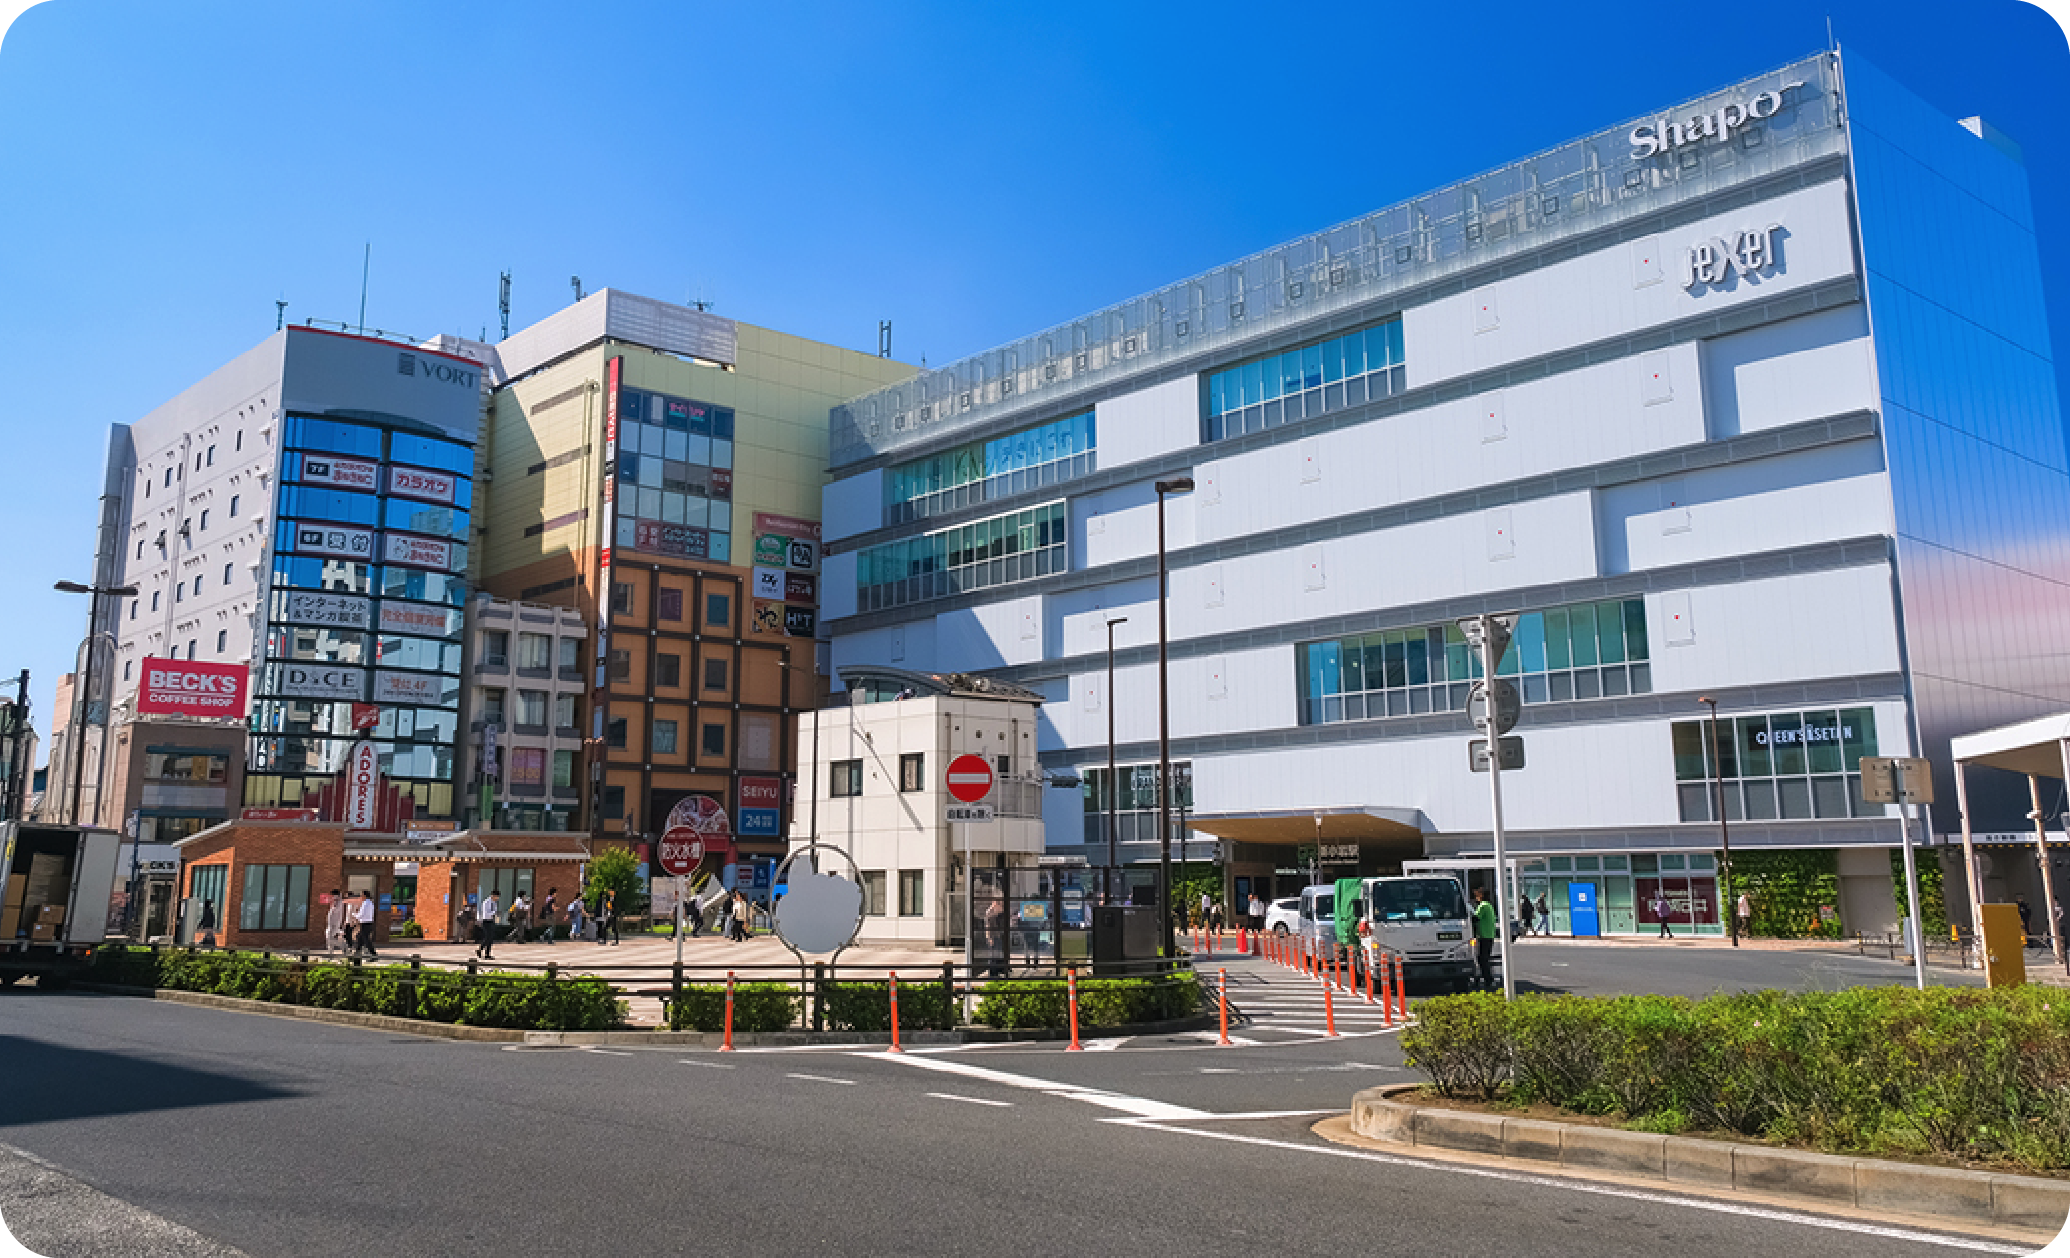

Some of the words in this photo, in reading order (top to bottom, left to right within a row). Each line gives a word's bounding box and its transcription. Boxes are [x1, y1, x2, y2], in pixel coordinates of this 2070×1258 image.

[1629, 82, 1805, 160] Shapo
[420, 360, 477, 389] VORT
[397, 473, 447, 492] カラオケ
[293, 595, 366, 611] インターネット
[150, 670, 238, 694] BECK'S
[150, 694, 197, 704] COFFEE
[200, 697, 234, 706] SHOP
[356, 745, 373, 824] ADORES
[742, 785, 778, 798] SEIYU
